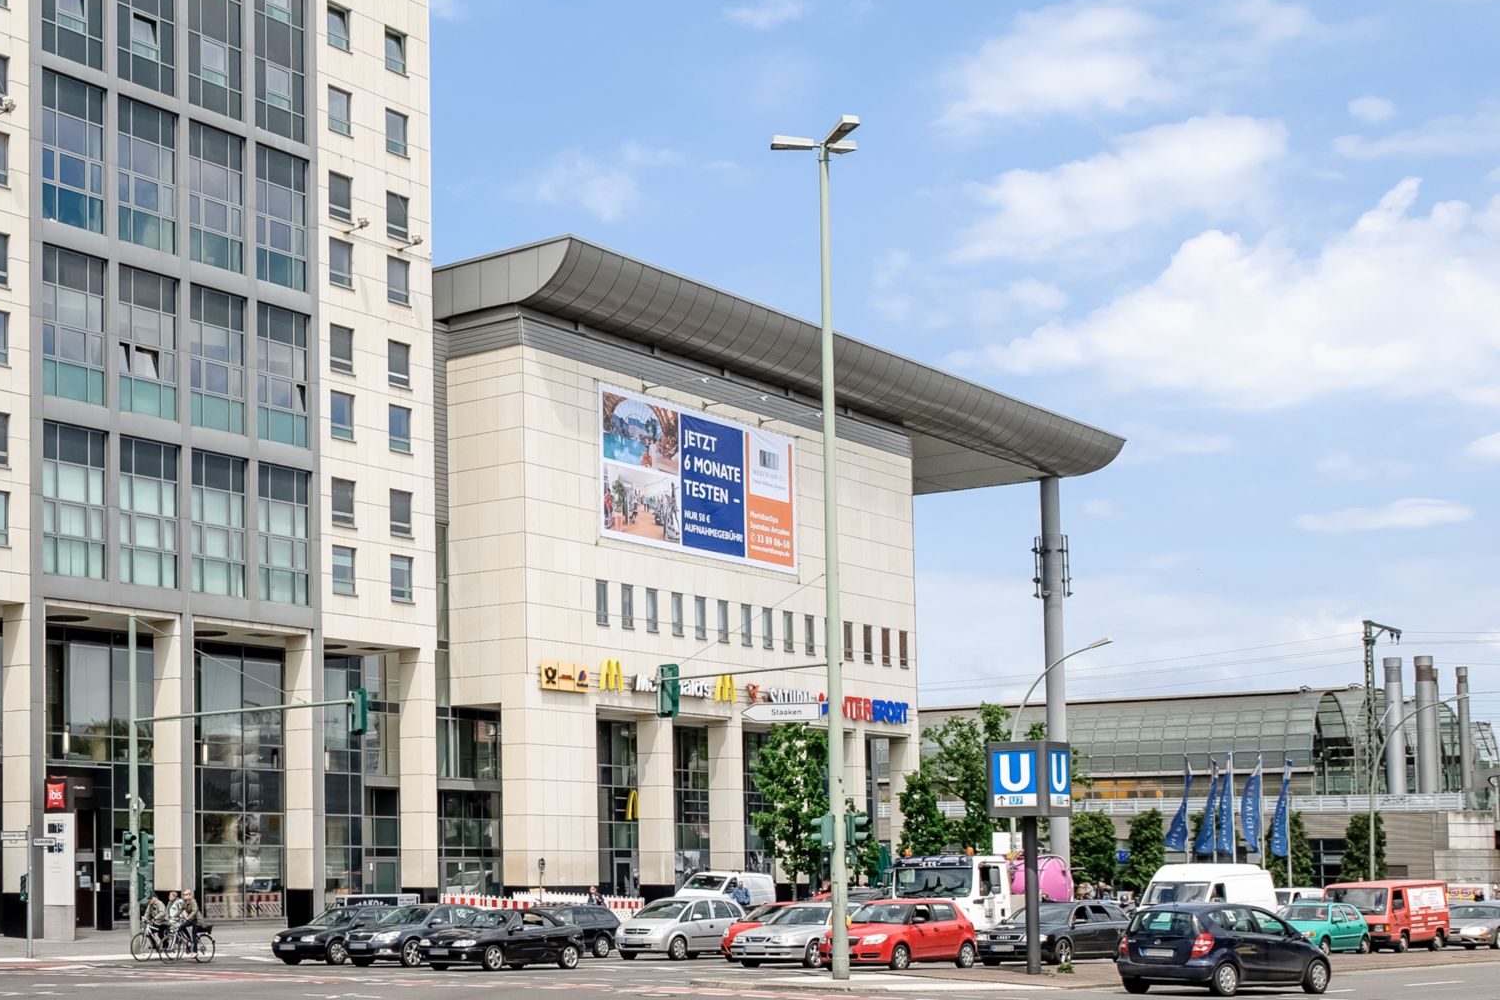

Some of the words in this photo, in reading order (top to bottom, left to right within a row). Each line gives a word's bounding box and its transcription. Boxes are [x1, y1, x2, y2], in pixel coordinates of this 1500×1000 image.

[683, 429, 717, 452] JETZT
[684, 454, 691, 470] 6
[693, 456, 741, 483] MONATE
[684, 479, 729, 504] TESTEN
[684, 509, 699, 522] NUR
[699, 513, 706, 523] 50
[771, 708, 802, 716] Staaken
[1000, 753, 1031, 792] U
[1051, 753, 1067, 792] U
[49, 789, 62, 800] ibis
